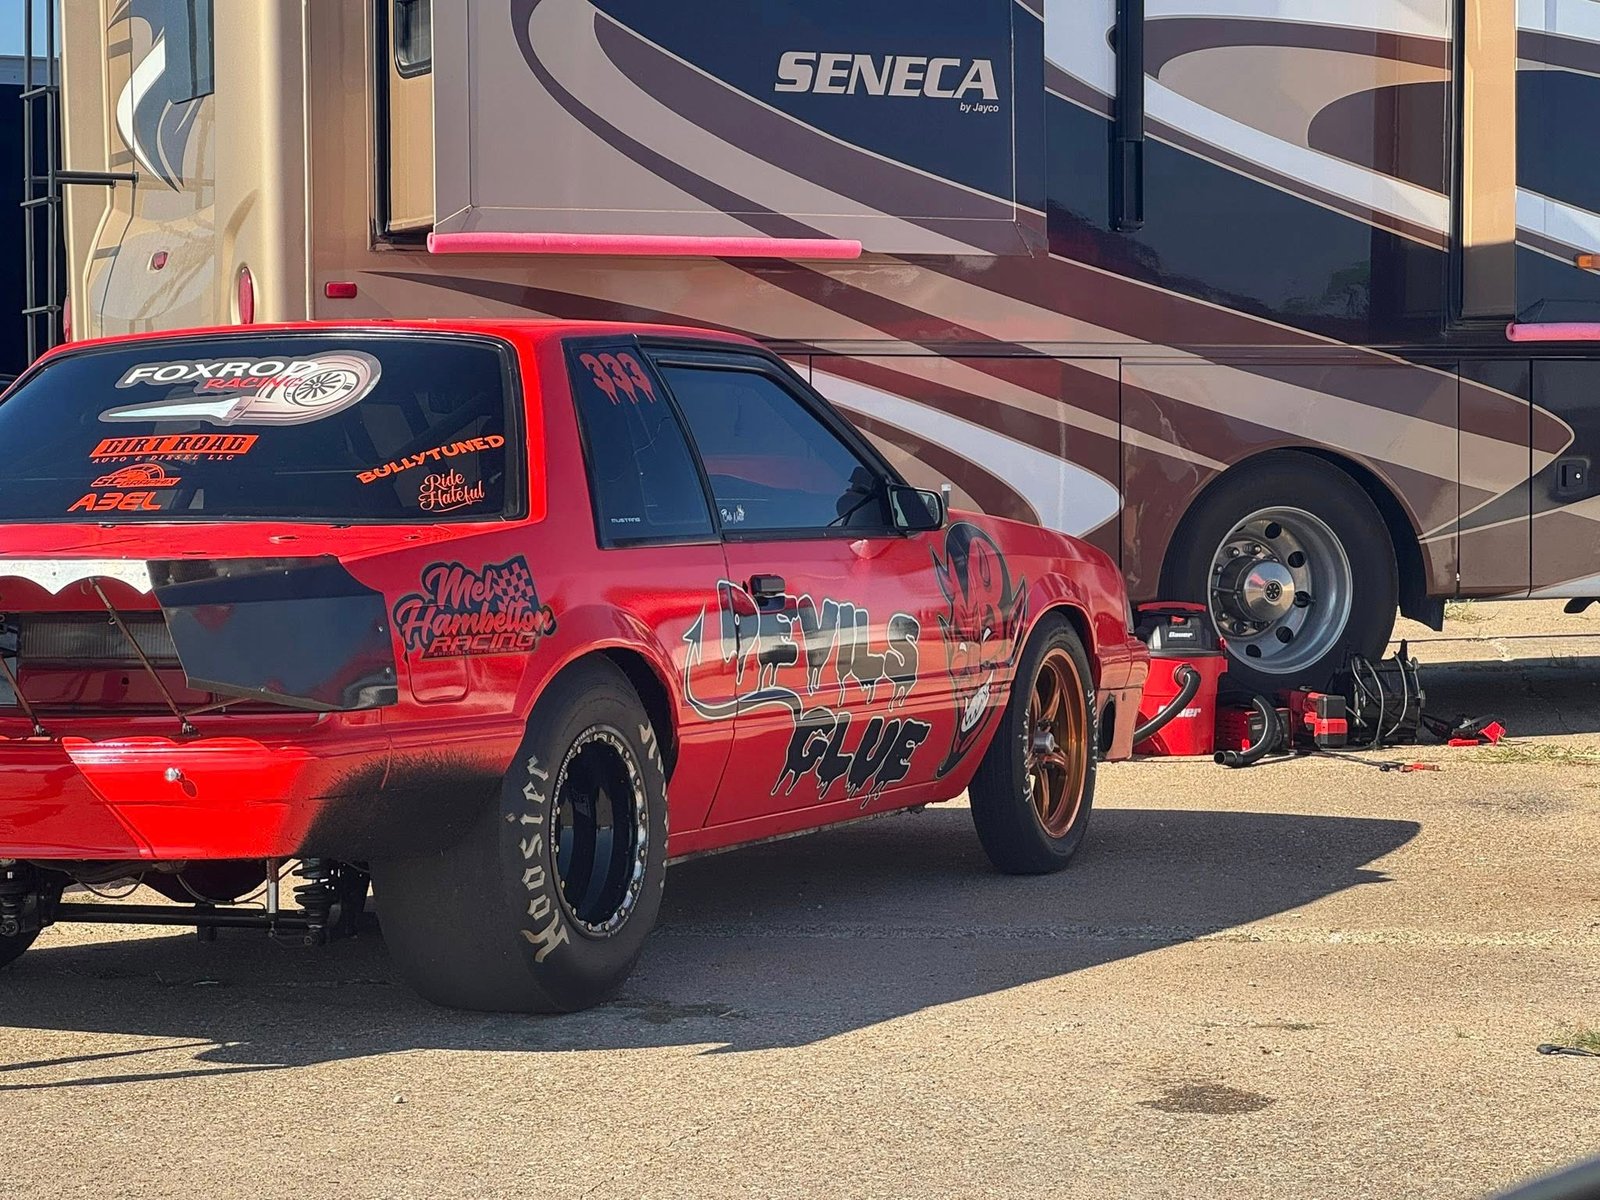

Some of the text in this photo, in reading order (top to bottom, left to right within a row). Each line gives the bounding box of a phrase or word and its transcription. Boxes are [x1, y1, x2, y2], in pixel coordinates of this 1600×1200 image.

[775, 51, 999, 100] SENECA
[960, 102, 999, 114] by Jayco
[124, 360, 318, 384] FOXROD
[203, 376, 304, 390] RACING
[579, 353, 657, 406] 333
[92, 456, 128, 464] AUTO
[101, 435, 248, 454] DIRT ROAD
[356, 435, 505, 484] BULLYTUNED
[418, 480, 486, 512] Hateful
[419, 468, 466, 494] Ride
[426, 564, 494, 610] Mel
[428, 630, 537, 653] RACING
[717, 579, 921, 712] DEVILS
[553, 747, 574, 804] ALUMINUM
[573, 726, 597, 748] WHEELS
[771, 705, 931, 810] GLUE
[505, 755, 570, 963] Hoosier
